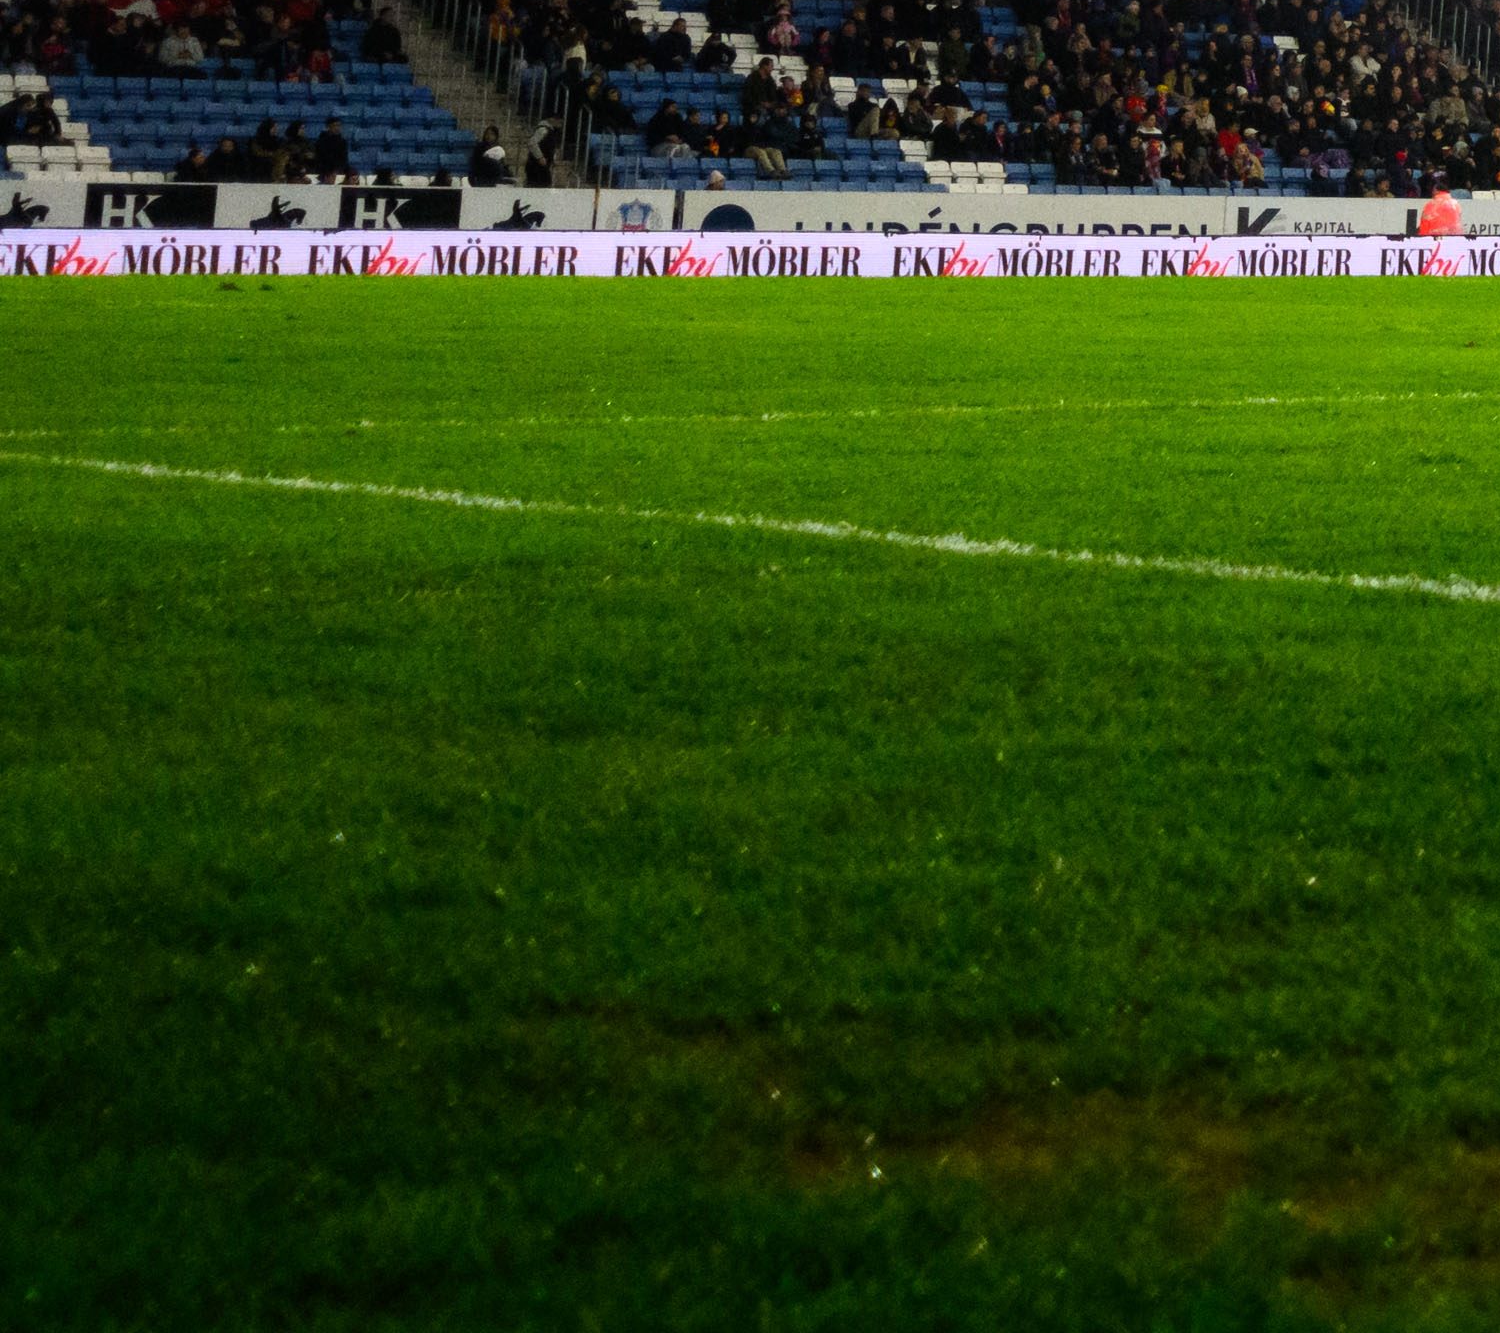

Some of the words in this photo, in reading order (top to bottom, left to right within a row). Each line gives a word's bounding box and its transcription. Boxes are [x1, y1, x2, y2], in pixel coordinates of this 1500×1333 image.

[100, 194, 164, 228] HK
[353, 197, 412, 229] HK
[1294, 221, 1355, 234] KAPITAL
[121, 235, 281, 275] MÖBLER
[307, 243, 381, 275] EKE
[431, 237, 578, 276] MÖBLER
[614, 244, 682, 276] EKE
[726, 238, 861, 276] MÖBLER
[892, 246, 956, 276] EKE
[996, 241, 1122, 276] MÖBLER
[1141, 247, 1199, 276] EKE
[1236, 242, 1352, 275] MÖBLER
[1379, 248, 1433, 275] EKE
